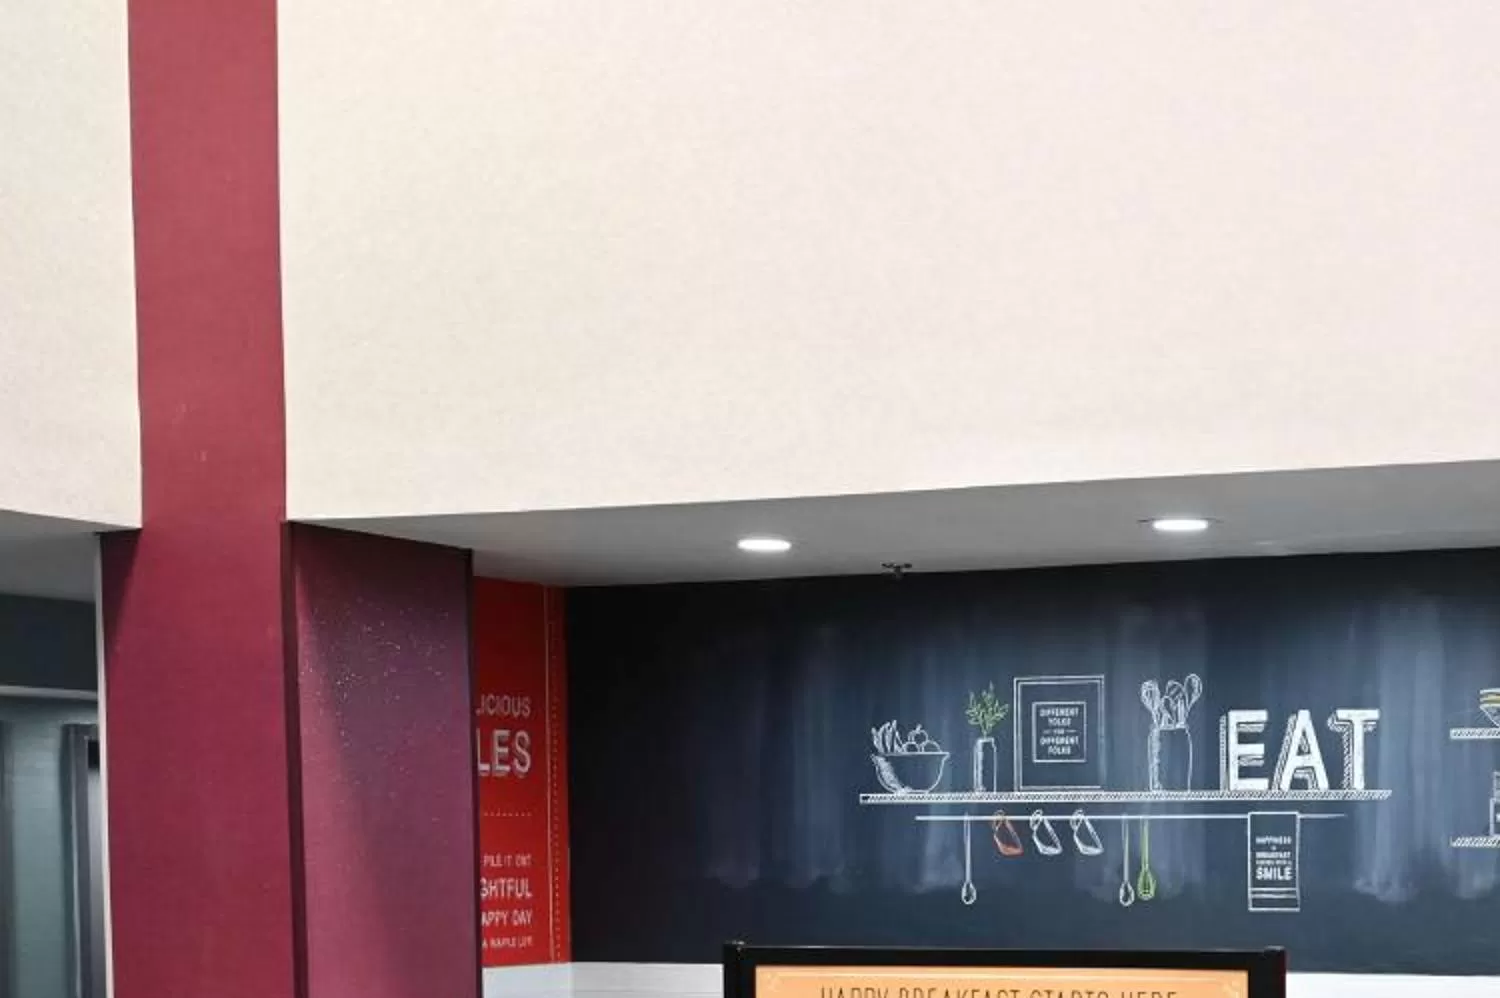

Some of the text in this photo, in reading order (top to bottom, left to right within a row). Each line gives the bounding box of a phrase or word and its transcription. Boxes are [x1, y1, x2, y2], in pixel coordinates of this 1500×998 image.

[1039, 707, 1079, 717] DIFFERENT
[1039, 736, 1079, 745] DIFFERENT
[476, 727, 531, 776] LES
[1220, 708, 1380, 791] EAT
[1255, 866, 1292, 880] SMILE
[512, 908, 533, 926] DAY
